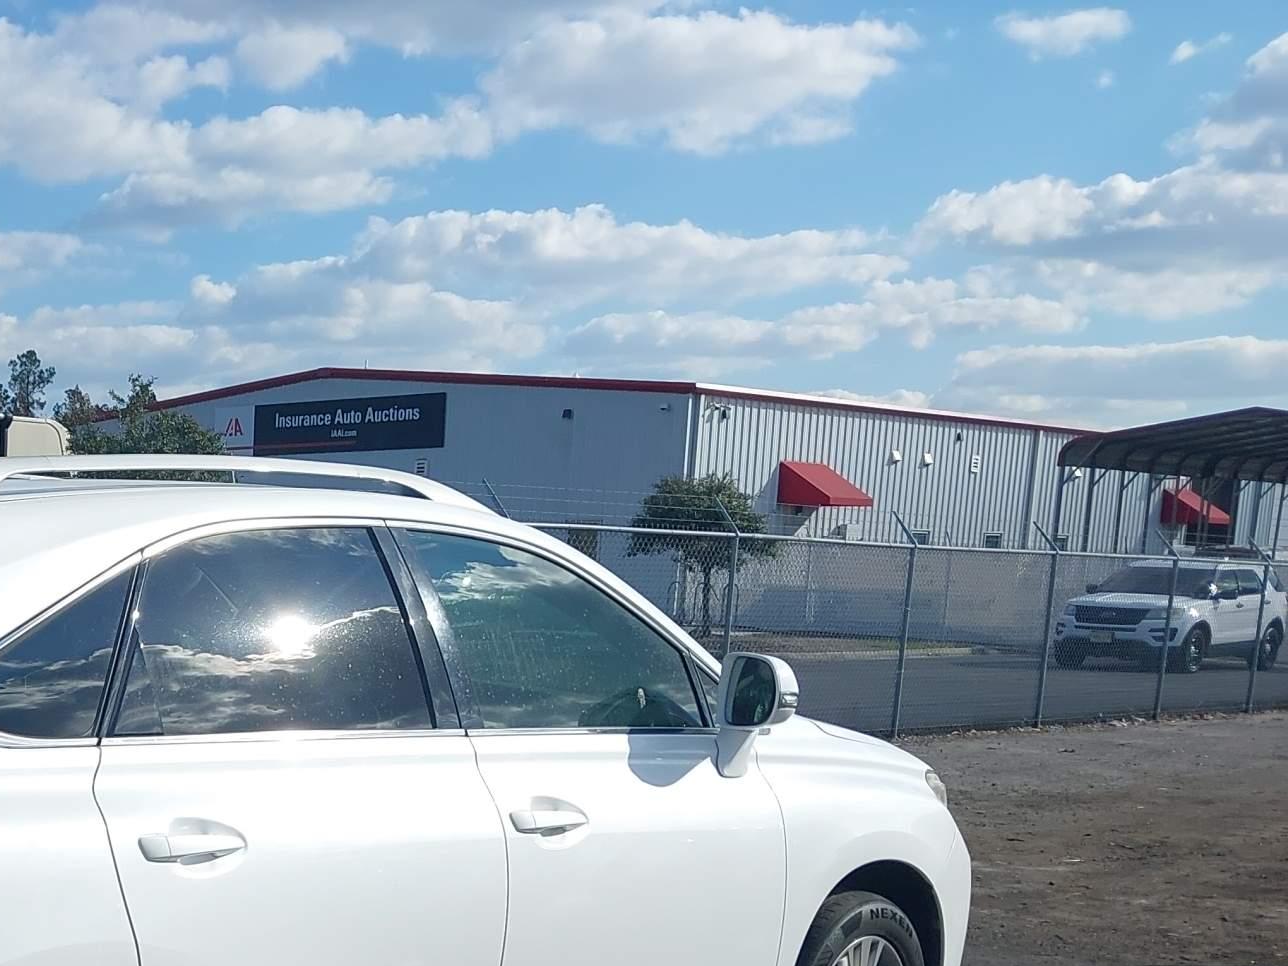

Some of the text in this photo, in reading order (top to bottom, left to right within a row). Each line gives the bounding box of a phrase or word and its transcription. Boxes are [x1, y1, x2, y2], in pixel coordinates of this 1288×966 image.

[275, 405, 420, 429] Insurance Auto Auctions
[869, 907, 913, 938] NEXEN
